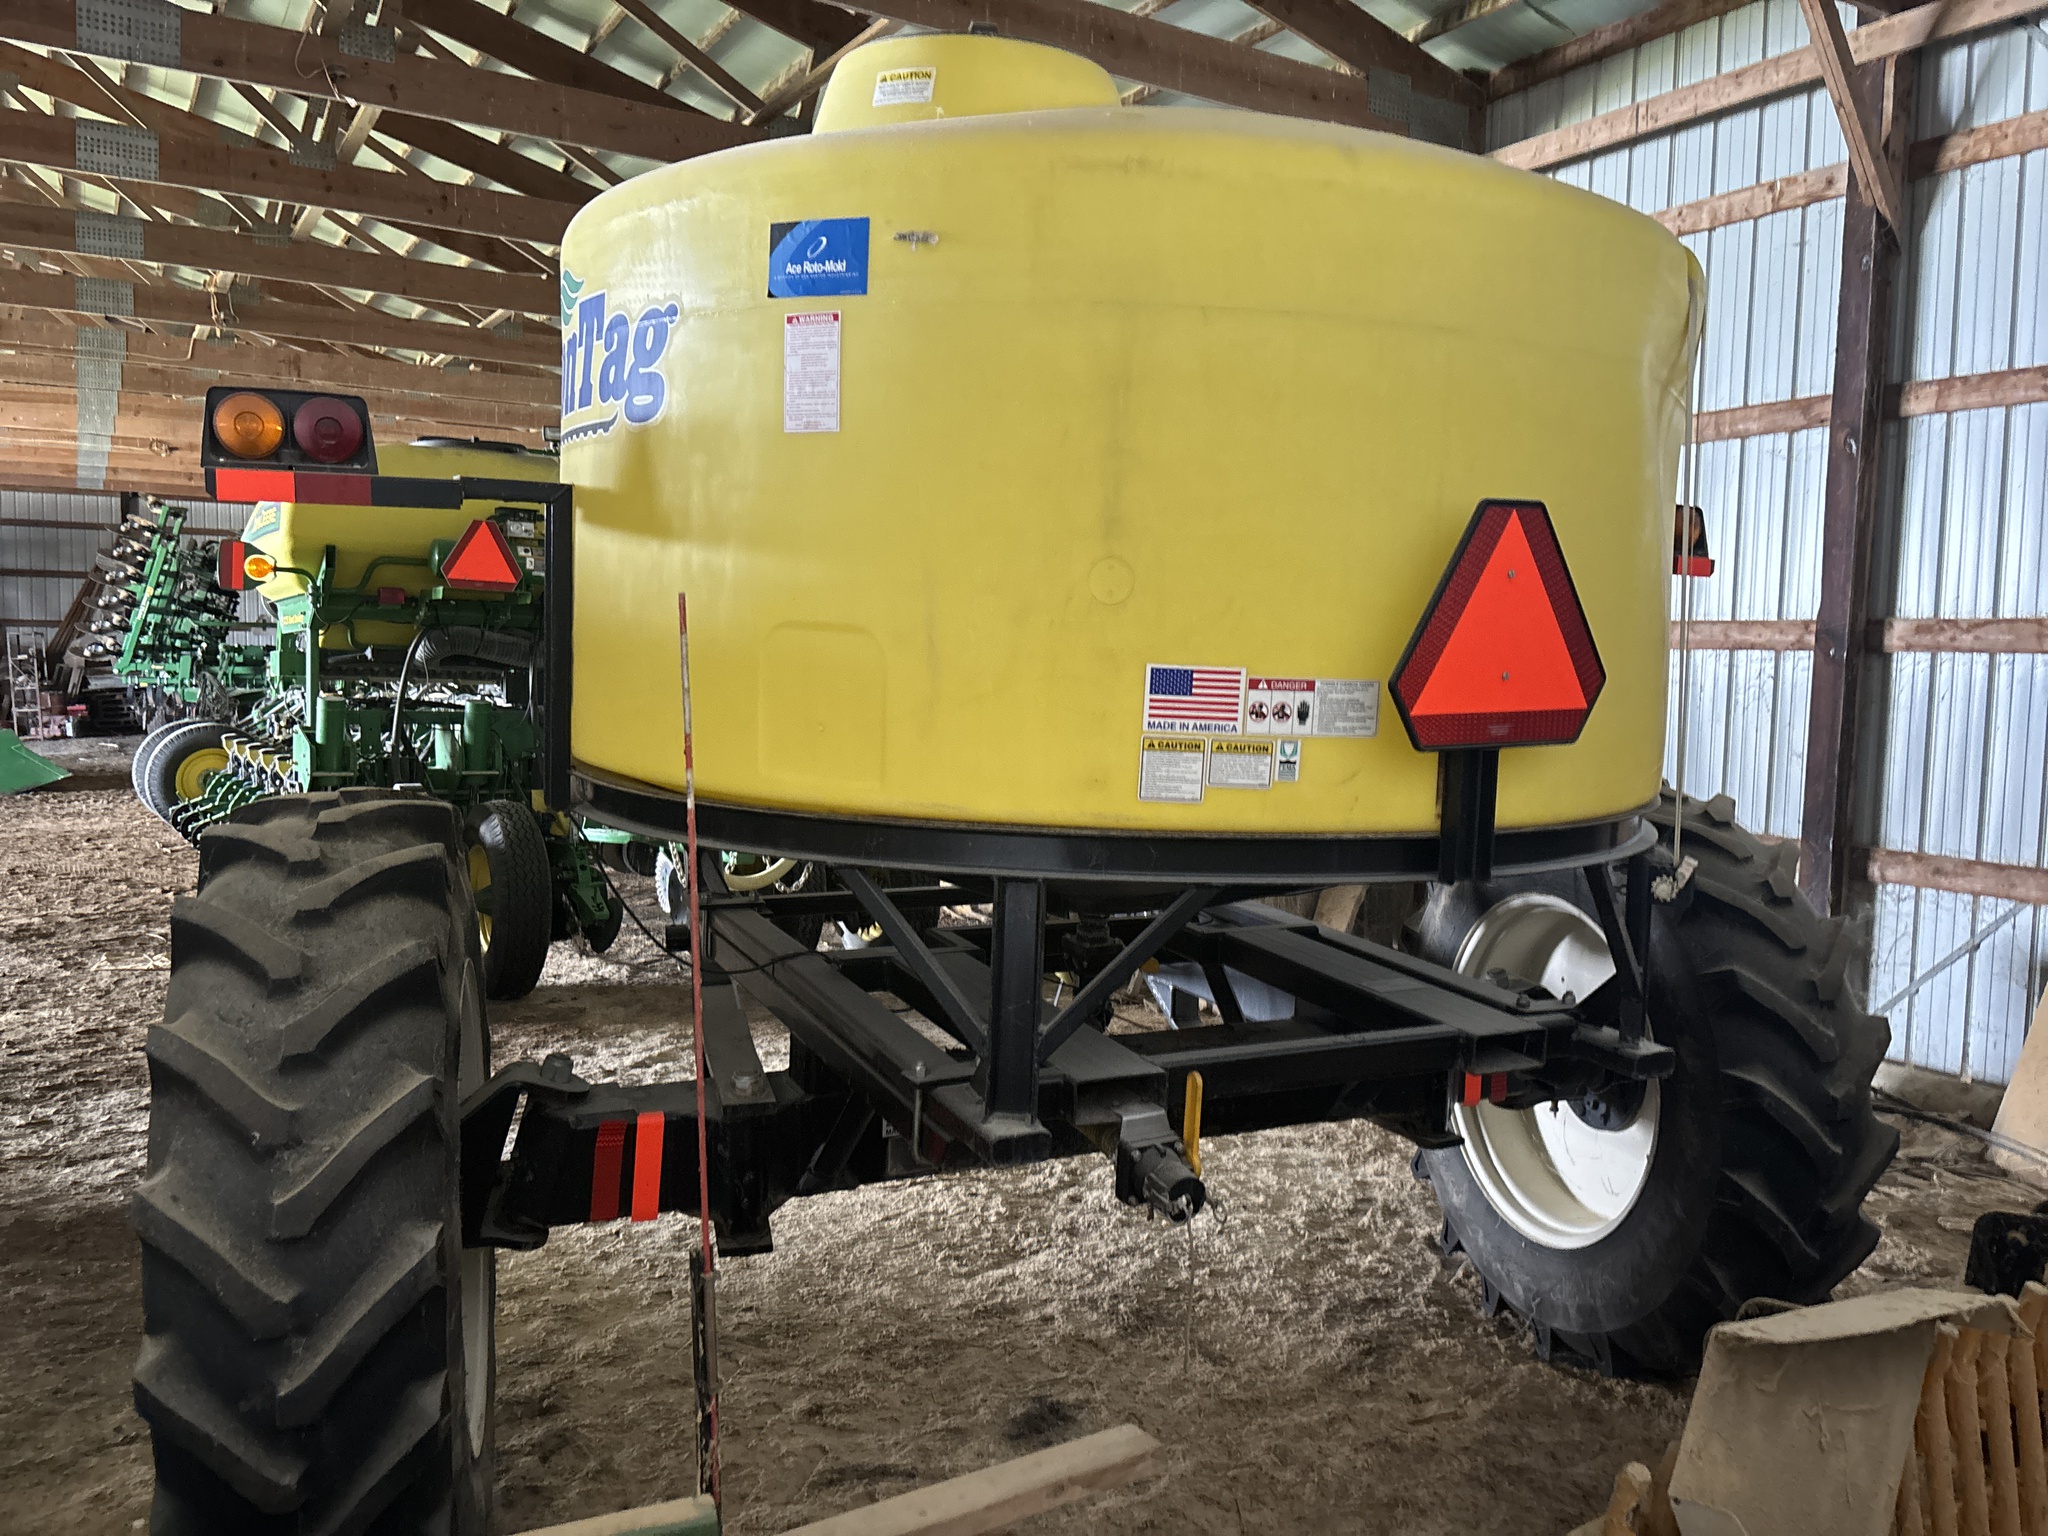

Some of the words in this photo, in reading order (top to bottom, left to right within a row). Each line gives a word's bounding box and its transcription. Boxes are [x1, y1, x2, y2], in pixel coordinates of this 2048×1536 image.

[890, 71, 932, 81] CAUTION
[785, 262, 801, 274] Ace
[803, 259, 847, 273] Roto-Mold
[799, 314, 834, 324] WARNING
[1271, 680, 1307, 690] DANGER
[1147, 721, 1176, 730] MADE
[1180, 722, 1190, 731] IN
[1191, 723, 1238, 733] AMERICA
[1157, 741, 1201, 749] CAUTION
[1226, 744, 1269, 752] CAUTION
